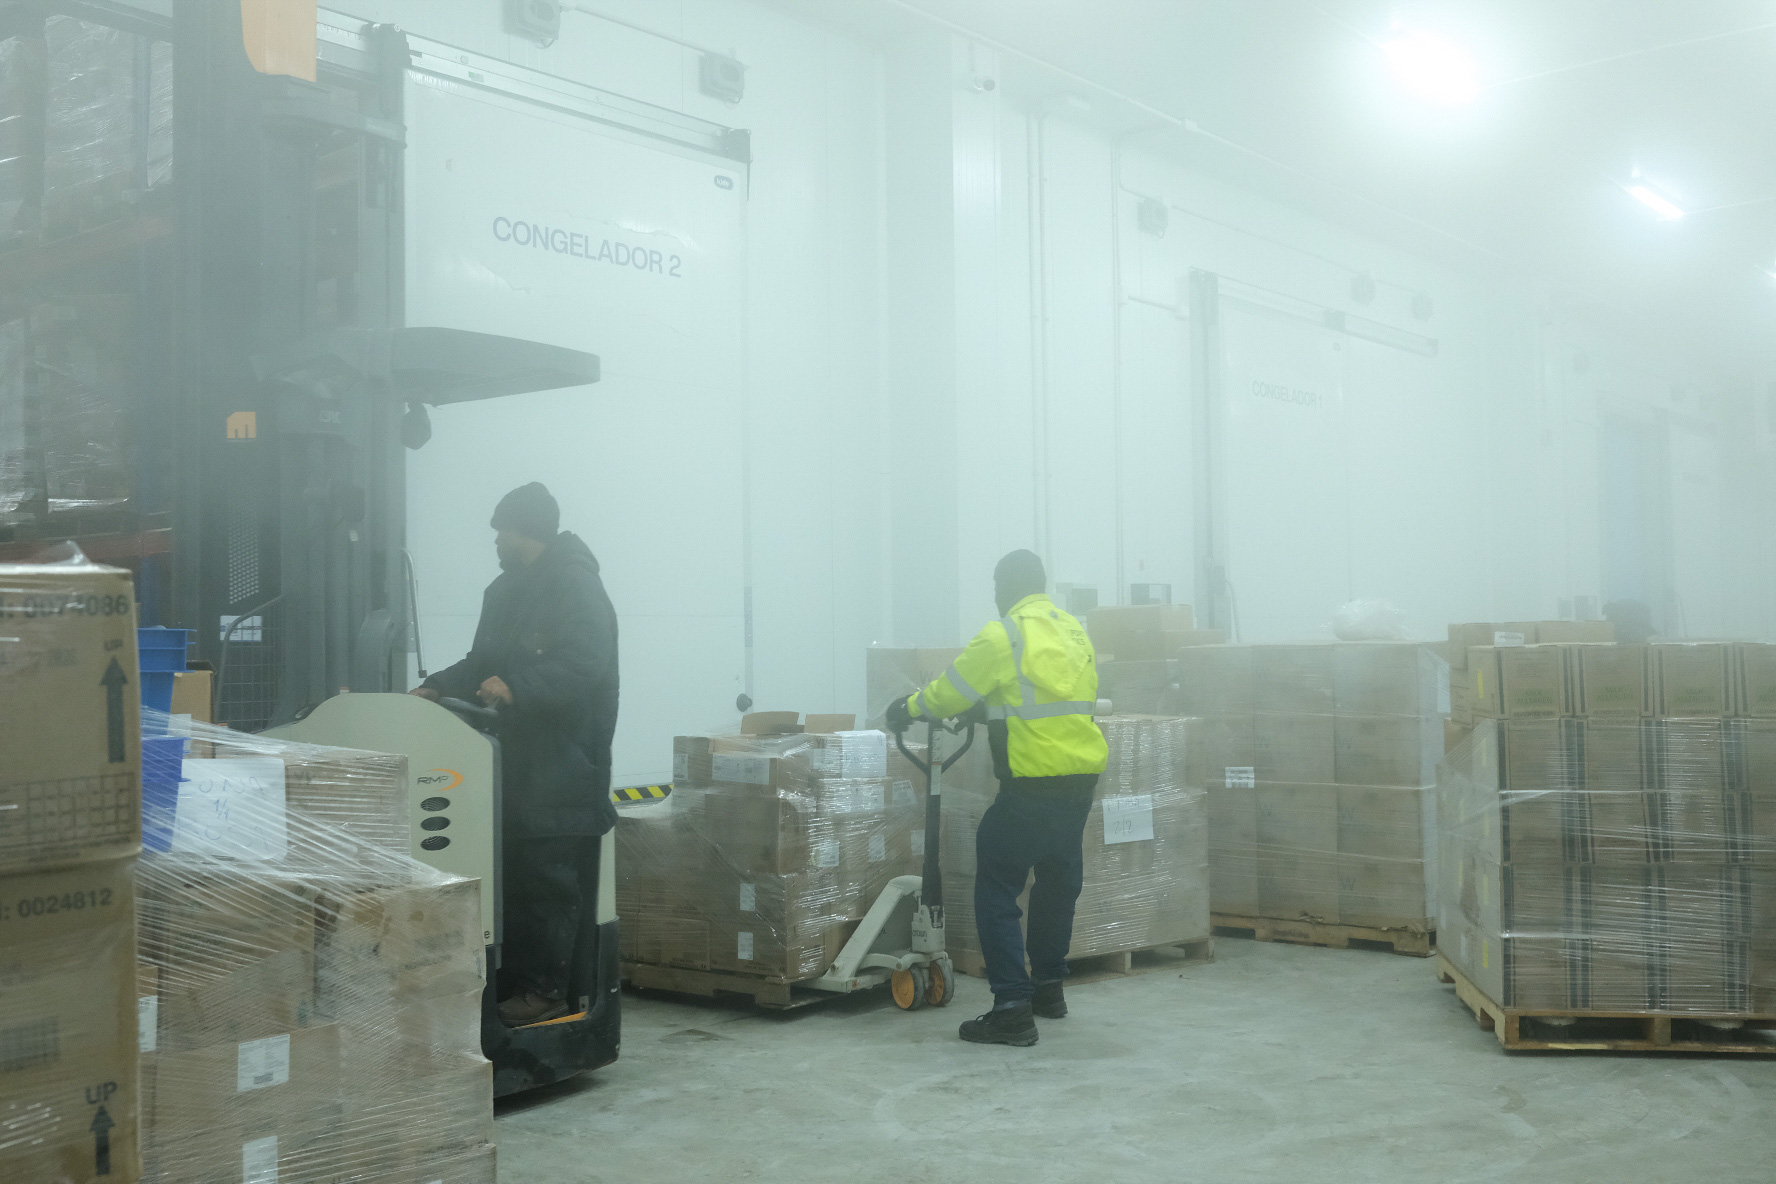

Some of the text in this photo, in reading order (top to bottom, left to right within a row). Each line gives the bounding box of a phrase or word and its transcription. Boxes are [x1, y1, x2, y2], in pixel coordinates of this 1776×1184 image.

[493, 216, 682, 278] CONGELADOR 2
[1252, 380, 1317, 407] CONGELADOR
[18, 887, 113, 918] 0024812
[85, 1080, 118, 1105] UP
